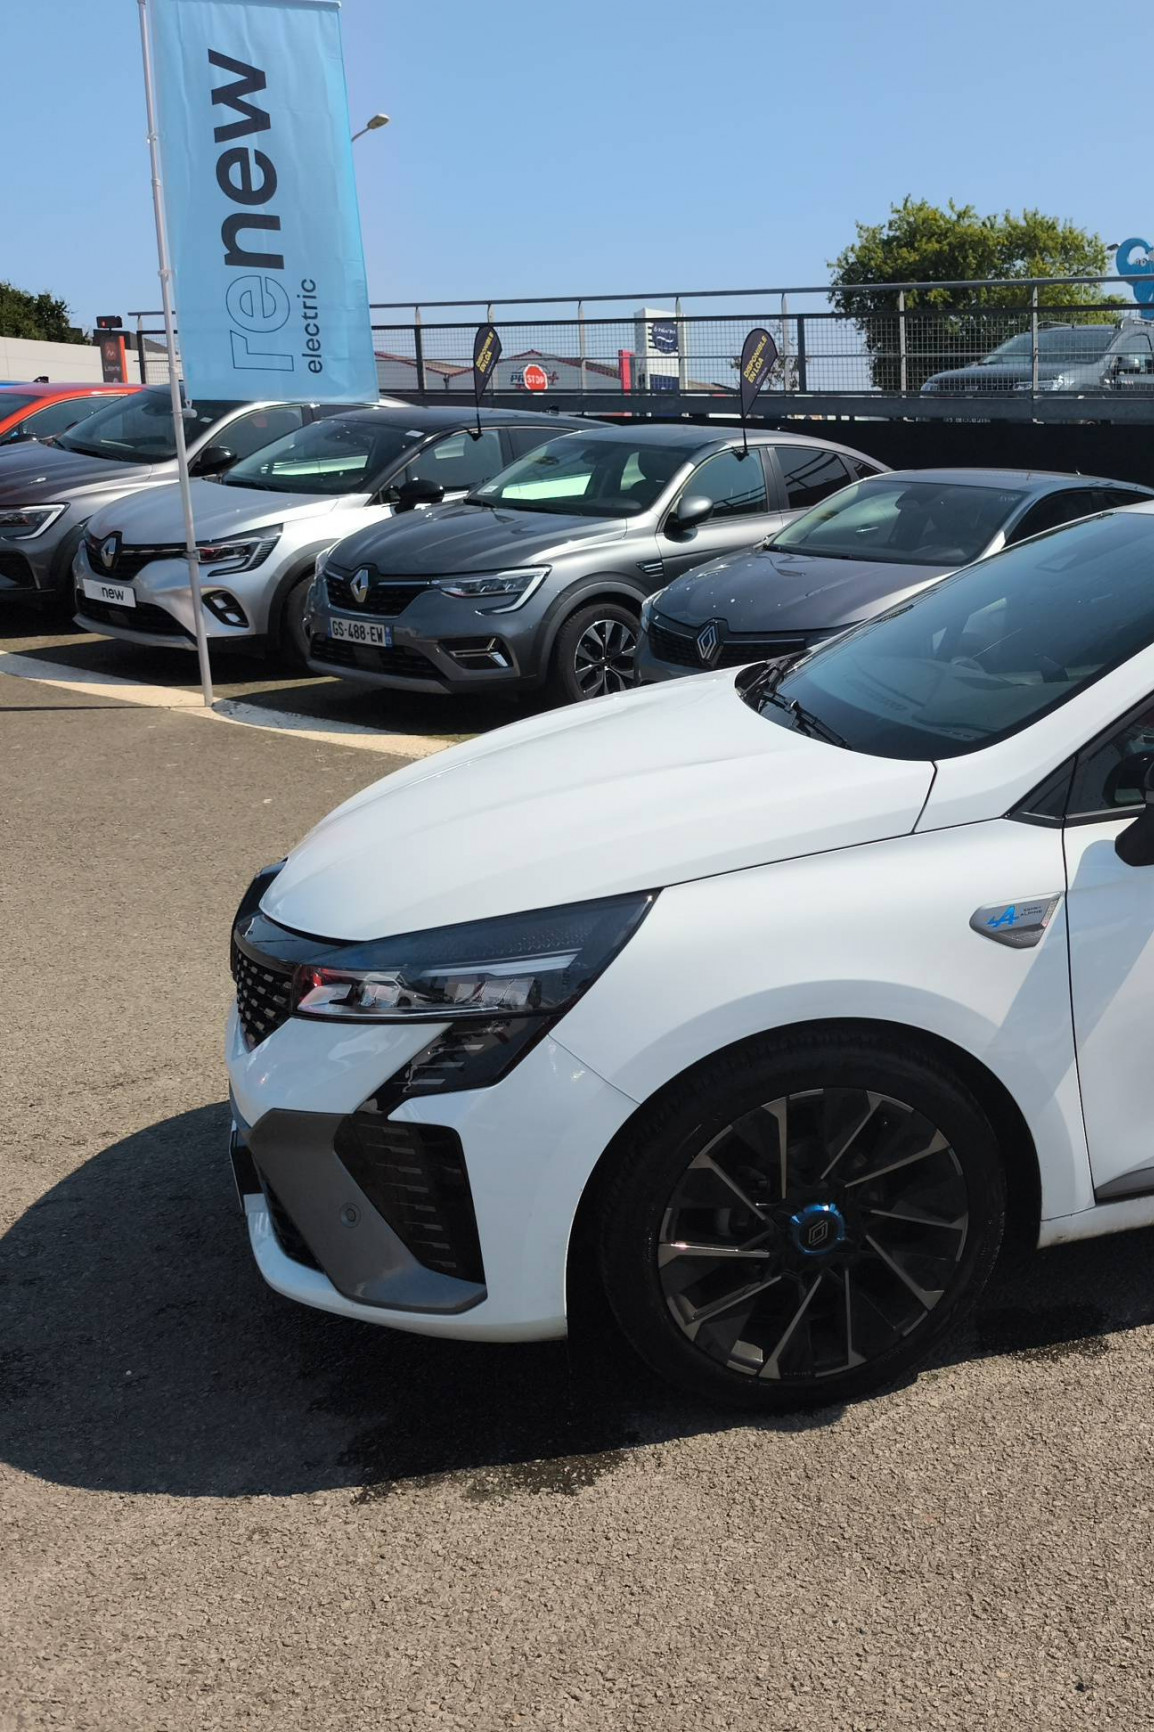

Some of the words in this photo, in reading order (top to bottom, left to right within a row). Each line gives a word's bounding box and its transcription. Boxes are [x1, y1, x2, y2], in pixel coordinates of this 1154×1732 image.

[207, 48, 295, 372] renew
[297, 277, 323, 375] electric
[743, 335, 768, 378] DISPONIBLE
[747, 370, 757, 384] EN
[753, 357, 764, 374] LOA
[527, 374, 544, 385] STOP
[332, 621, 383, 643] GS-488-EW
